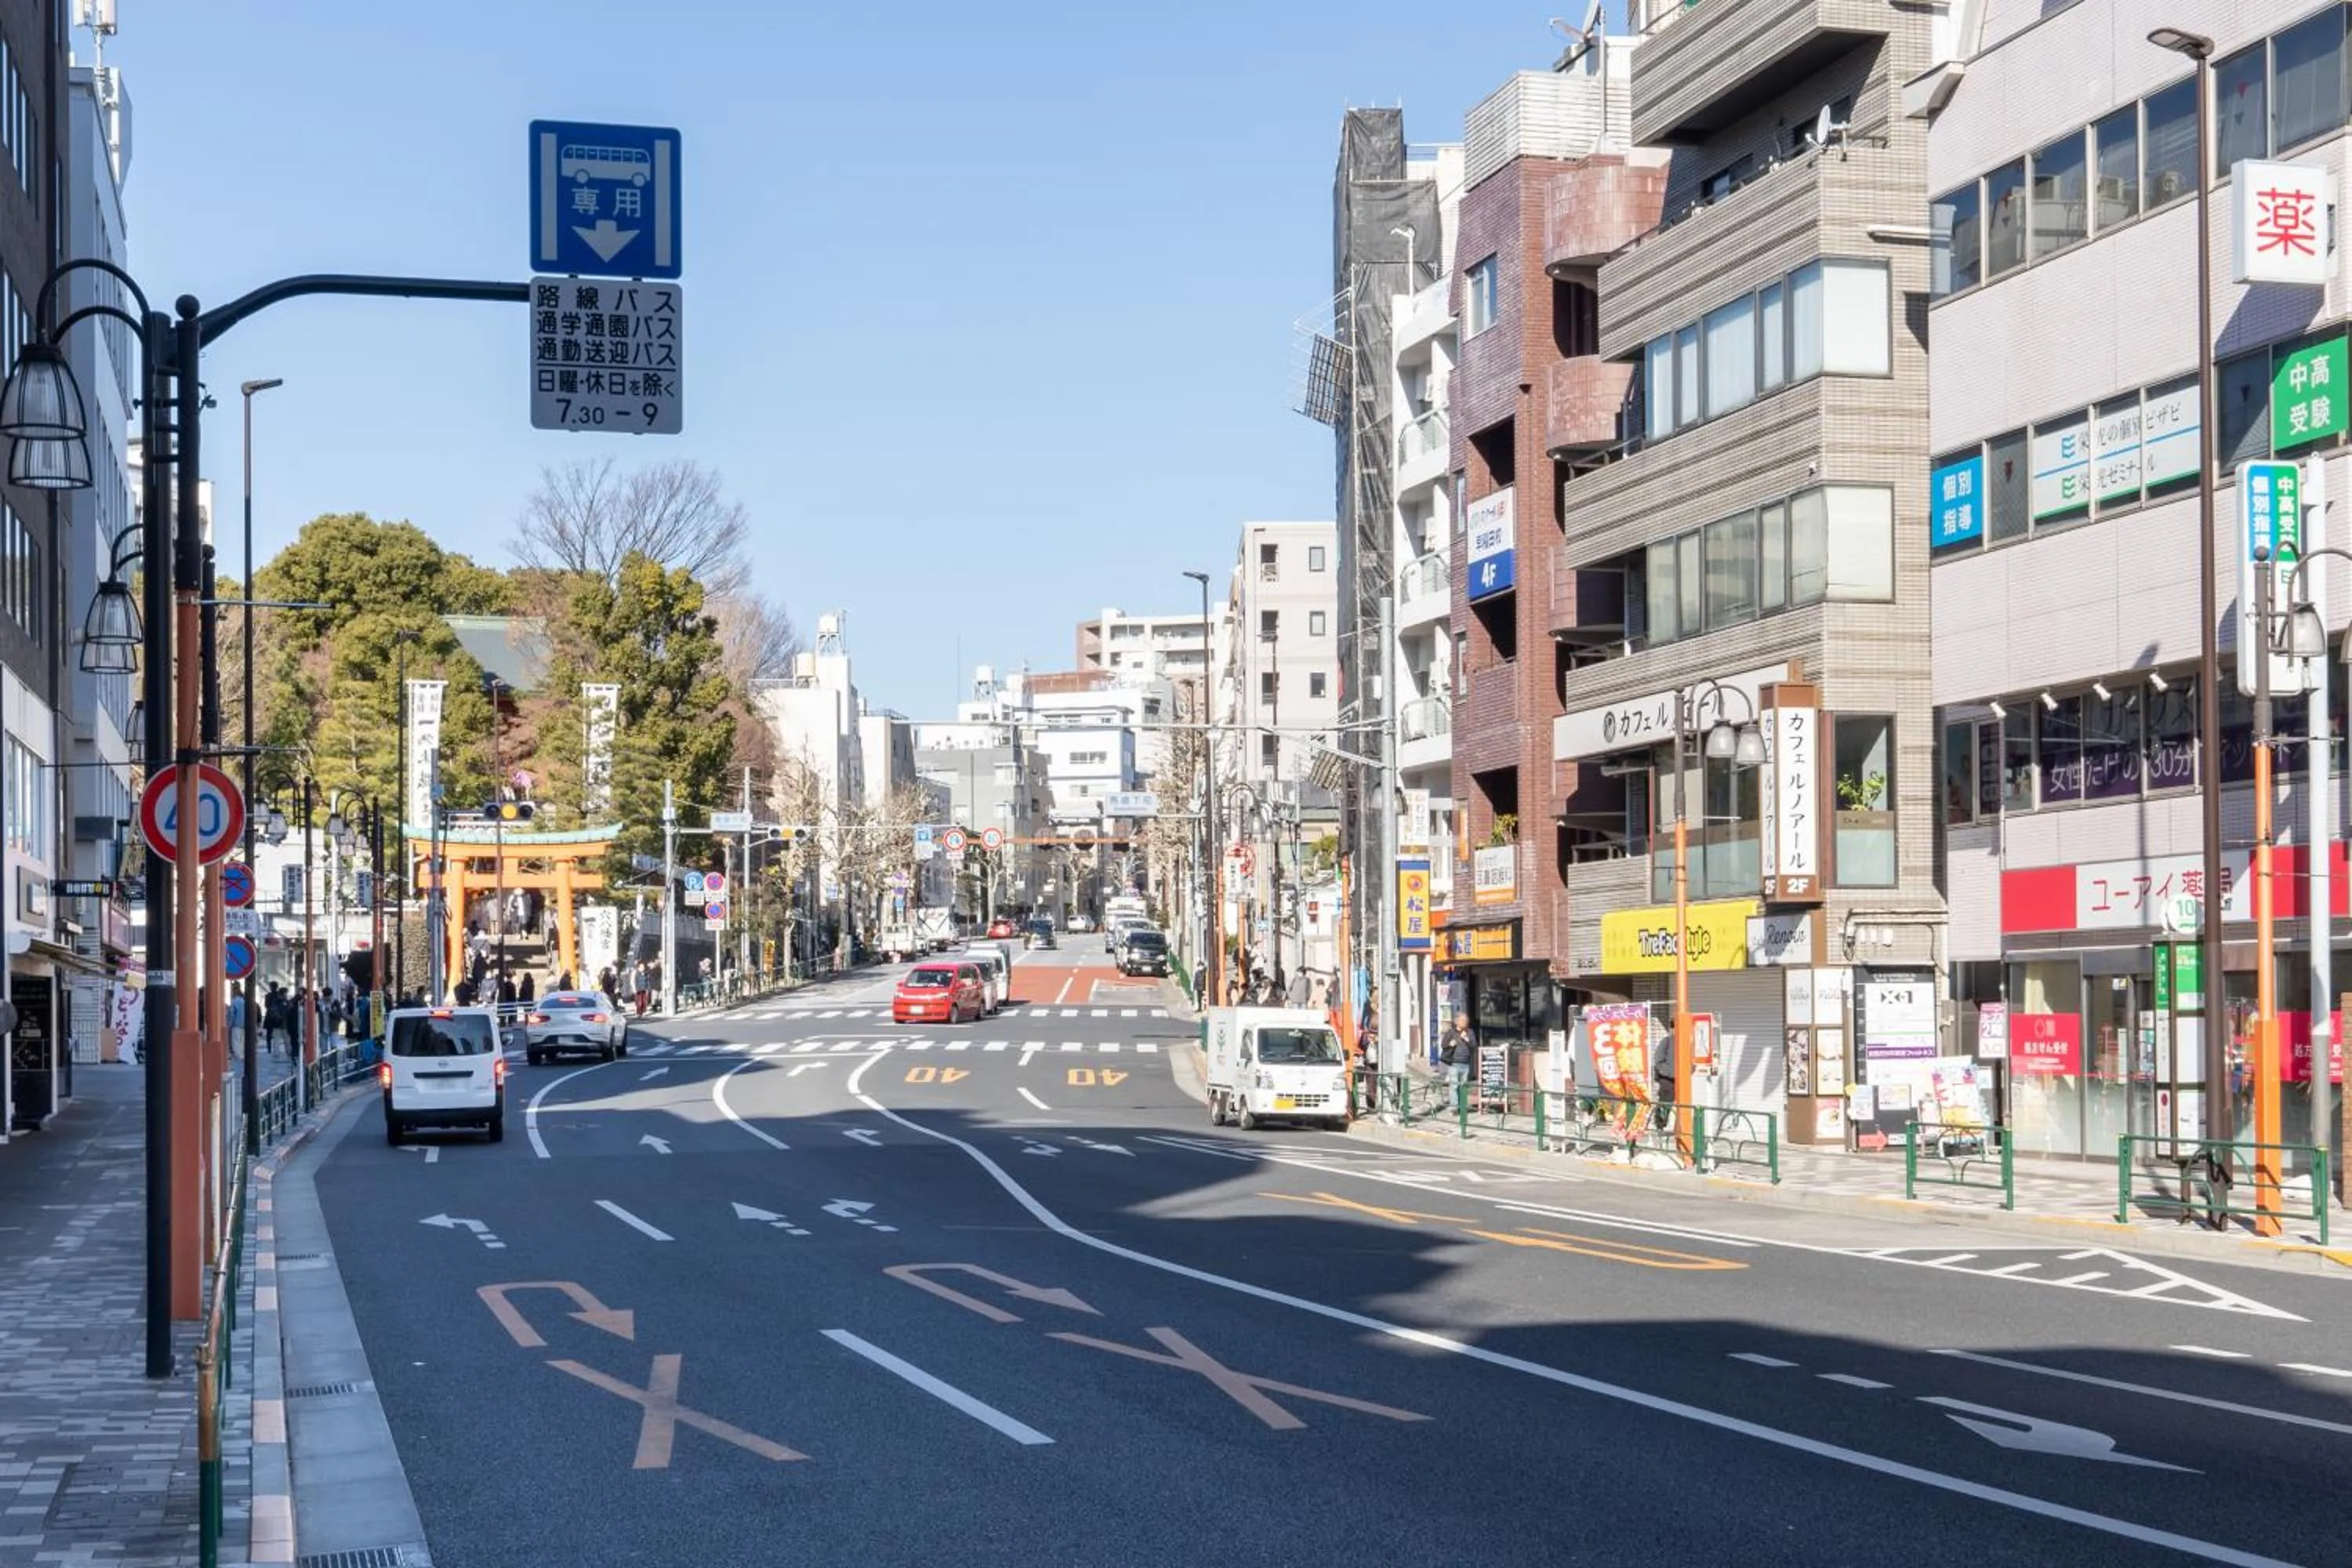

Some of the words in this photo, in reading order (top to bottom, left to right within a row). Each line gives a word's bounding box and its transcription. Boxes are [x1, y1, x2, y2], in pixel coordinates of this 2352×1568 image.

[571, 187, 641, 219] 専用
[2256, 187, 2316, 256] 薬
[537, 285, 676, 314] 路線バス
[537, 311, 676, 339] 通学通園バス
[537, 338, 676, 366] 通勤送迎バス
[2289, 355, 2331, 393] 中高
[2289, 396, 2331, 436] 受験
[1481, 562, 1497, 587] 4F
[1788, 713, 1807, 869] カフェルノアール
[1786, 878, 1809, 894] 2F
[1407, 895, 1424, 933] 松屋
[2176, 899, 2194, 916] 10
